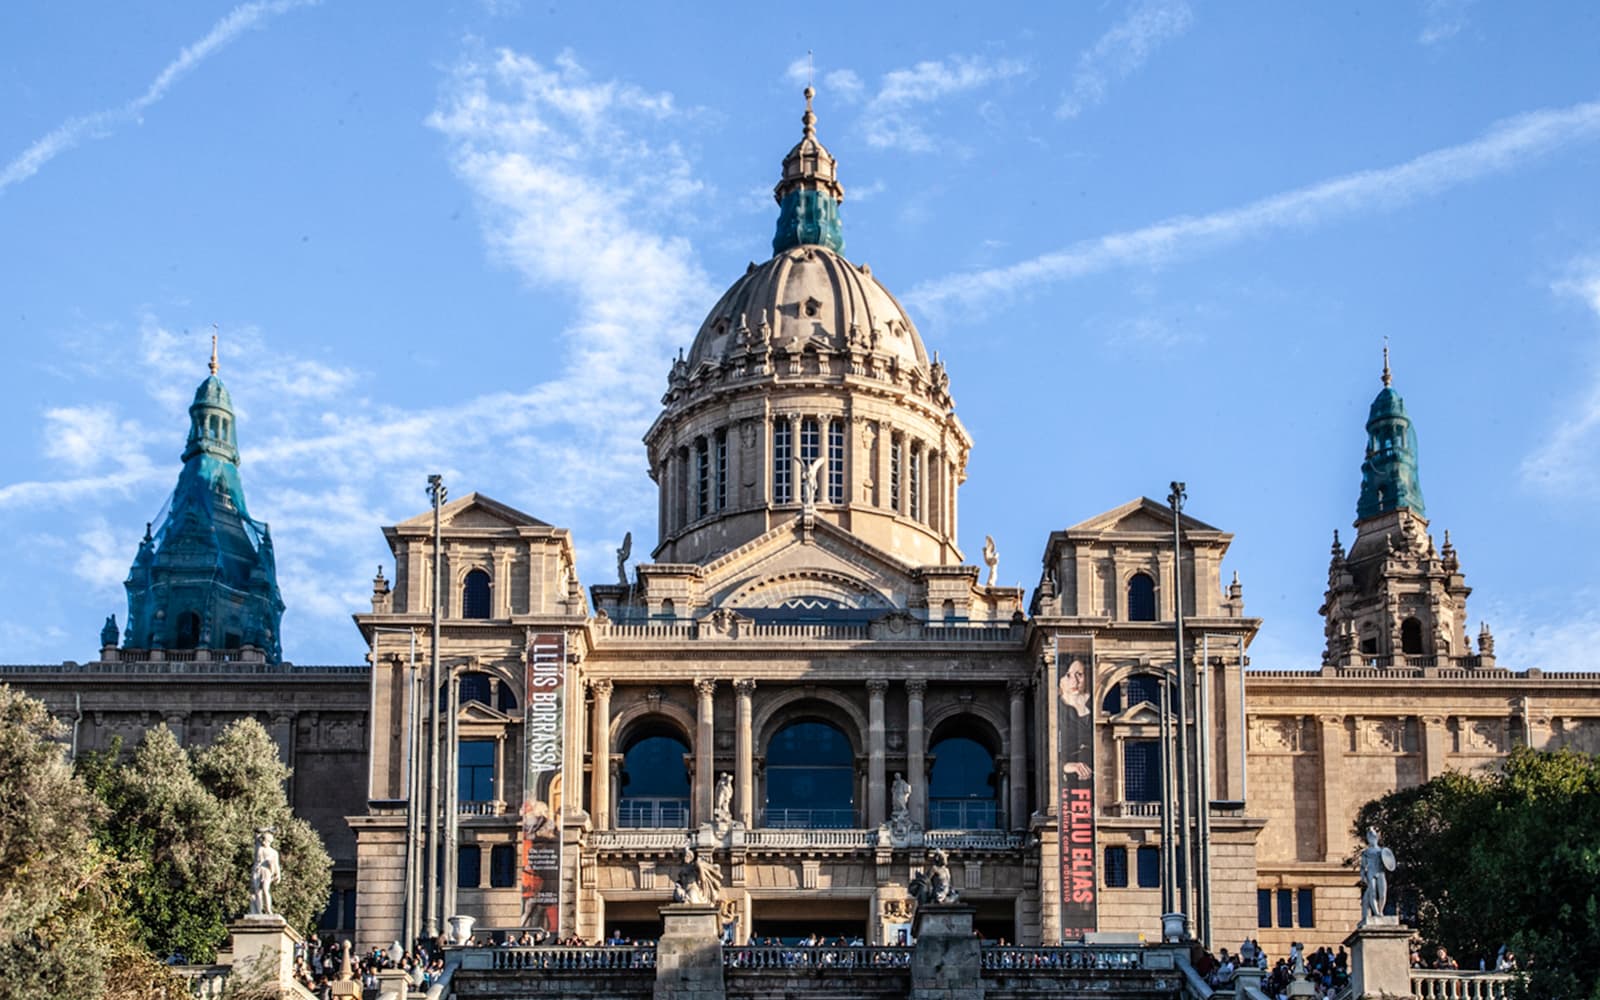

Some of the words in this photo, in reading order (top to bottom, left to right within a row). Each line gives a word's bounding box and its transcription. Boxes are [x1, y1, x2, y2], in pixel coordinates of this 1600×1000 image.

[533, 644, 564, 687] LLUÍS
[531, 692, 562, 773] BORRASSÀ
[1071, 788, 1092, 843] FELIU
[1072, 848, 1093, 903] ELIAS
